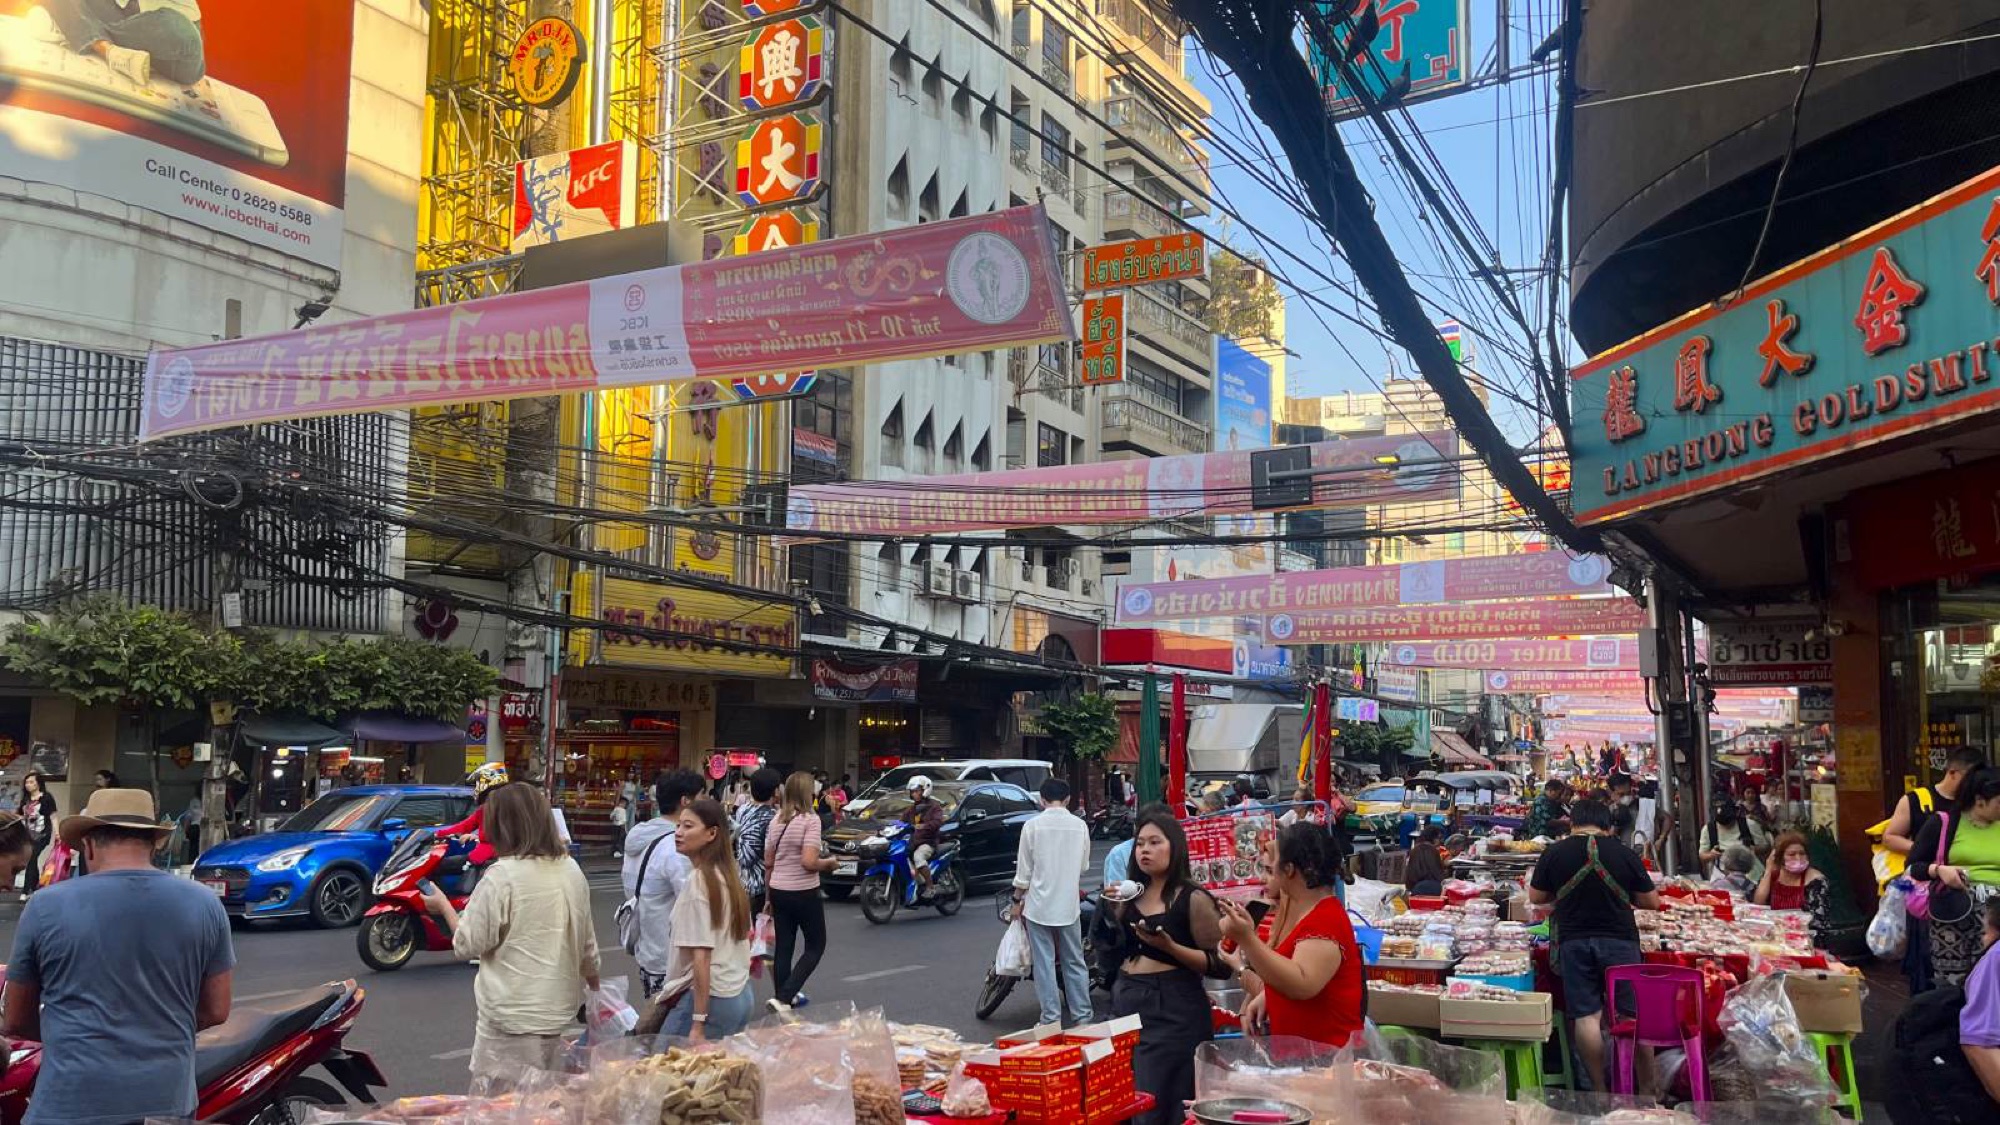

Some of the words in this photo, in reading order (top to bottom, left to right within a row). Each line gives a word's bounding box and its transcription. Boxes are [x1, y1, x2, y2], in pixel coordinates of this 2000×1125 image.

[145, 159, 176, 180] Call
[179, 170, 229, 197] Center
[231, 188, 240, 201] 0
[243, 192, 277, 214] 2629
[279, 205, 312, 226] 5588
[572, 160, 615, 200] KFC
[182, 192, 311, 246] www.icbcthai.com
[1086, 236, 1202, 286] โรงรับจำนำ
[1604, 412, 1774, 496] LANGHONG
[1793, 333, 2000, 436] GOLDSMI
